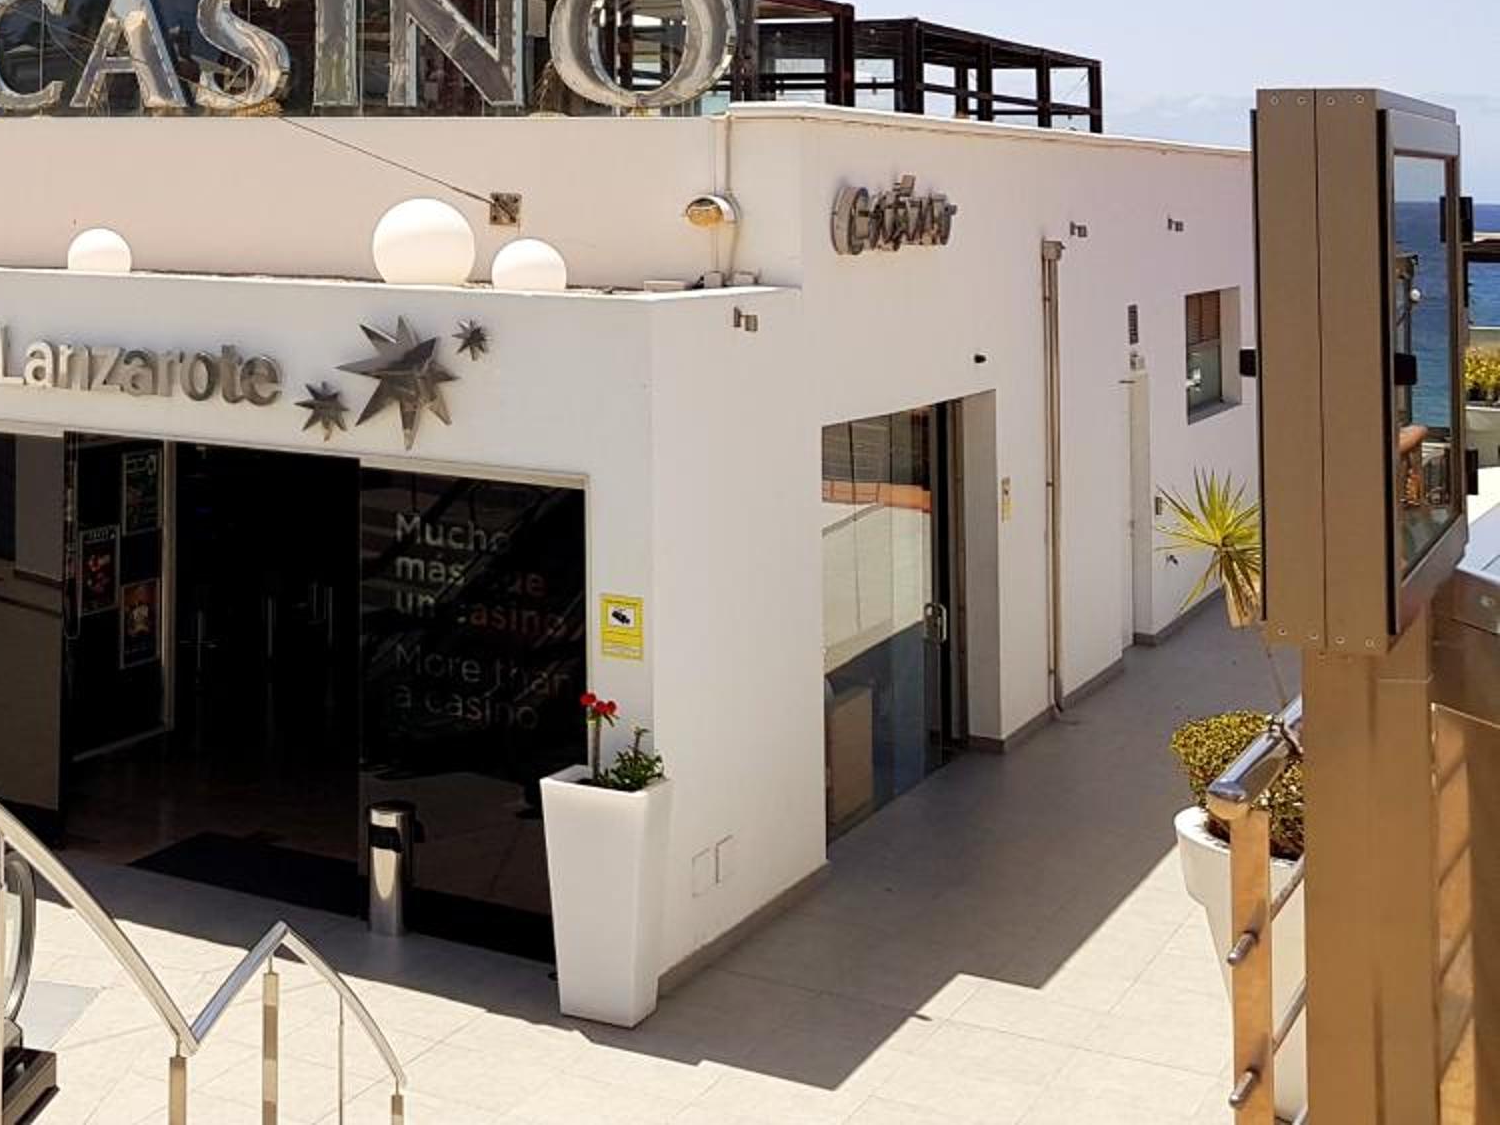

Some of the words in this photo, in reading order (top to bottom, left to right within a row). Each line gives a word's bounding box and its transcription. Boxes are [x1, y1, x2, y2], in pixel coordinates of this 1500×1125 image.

[395, 512, 511, 553] Mucho
[395, 589, 437, 618] un
[395, 642, 482, 683] More
[394, 684, 412, 709] a
[423, 689, 539, 730] casino
